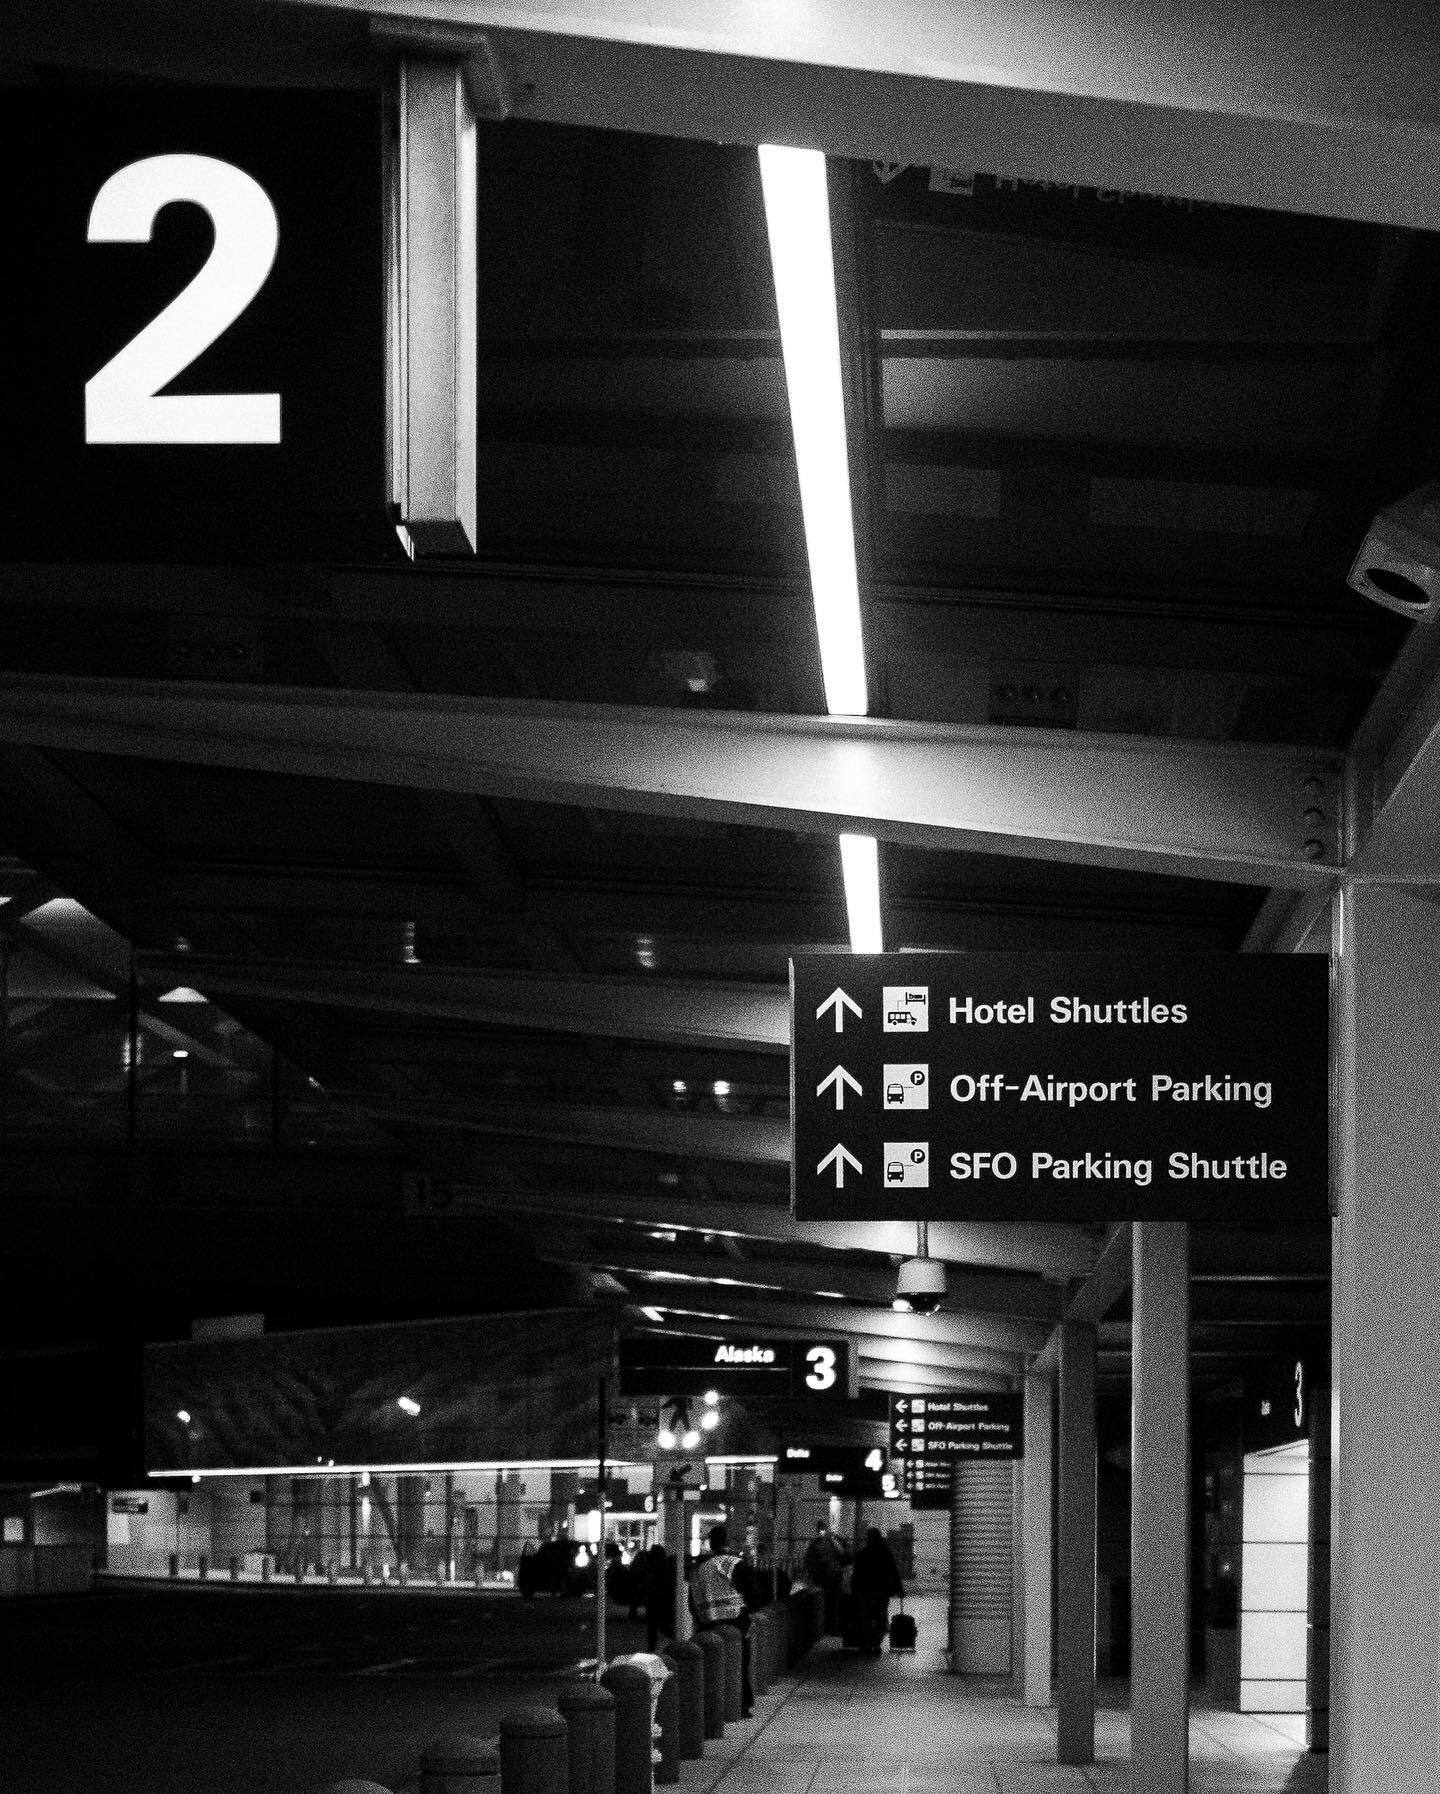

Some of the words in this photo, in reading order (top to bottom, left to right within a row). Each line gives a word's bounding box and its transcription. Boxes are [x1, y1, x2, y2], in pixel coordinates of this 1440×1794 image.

[85, 153, 281, 445] 2
[949, 996, 1034, 1024] Hotel
[1050, 996, 1188, 1024] Shuttles
[950, 1074, 1137, 1108] Off-Airport
[1152, 1074, 1272, 1109] Parking
[949, 1152, 1017, 1180] SFO
[1032, 1152, 1152, 1186] Parking
[1168, 1151, 1287, 1179] Shuttle
[714, 1345, 775, 1364] Alaska
[805, 1346, 837, 1390] 3
[927, 1402, 951, 1411] Hotel
[978, 1422, 1010, 1432] Parking
[927, 1441, 947, 1450] SFO
[864, 1448, 883, 1471] 4
